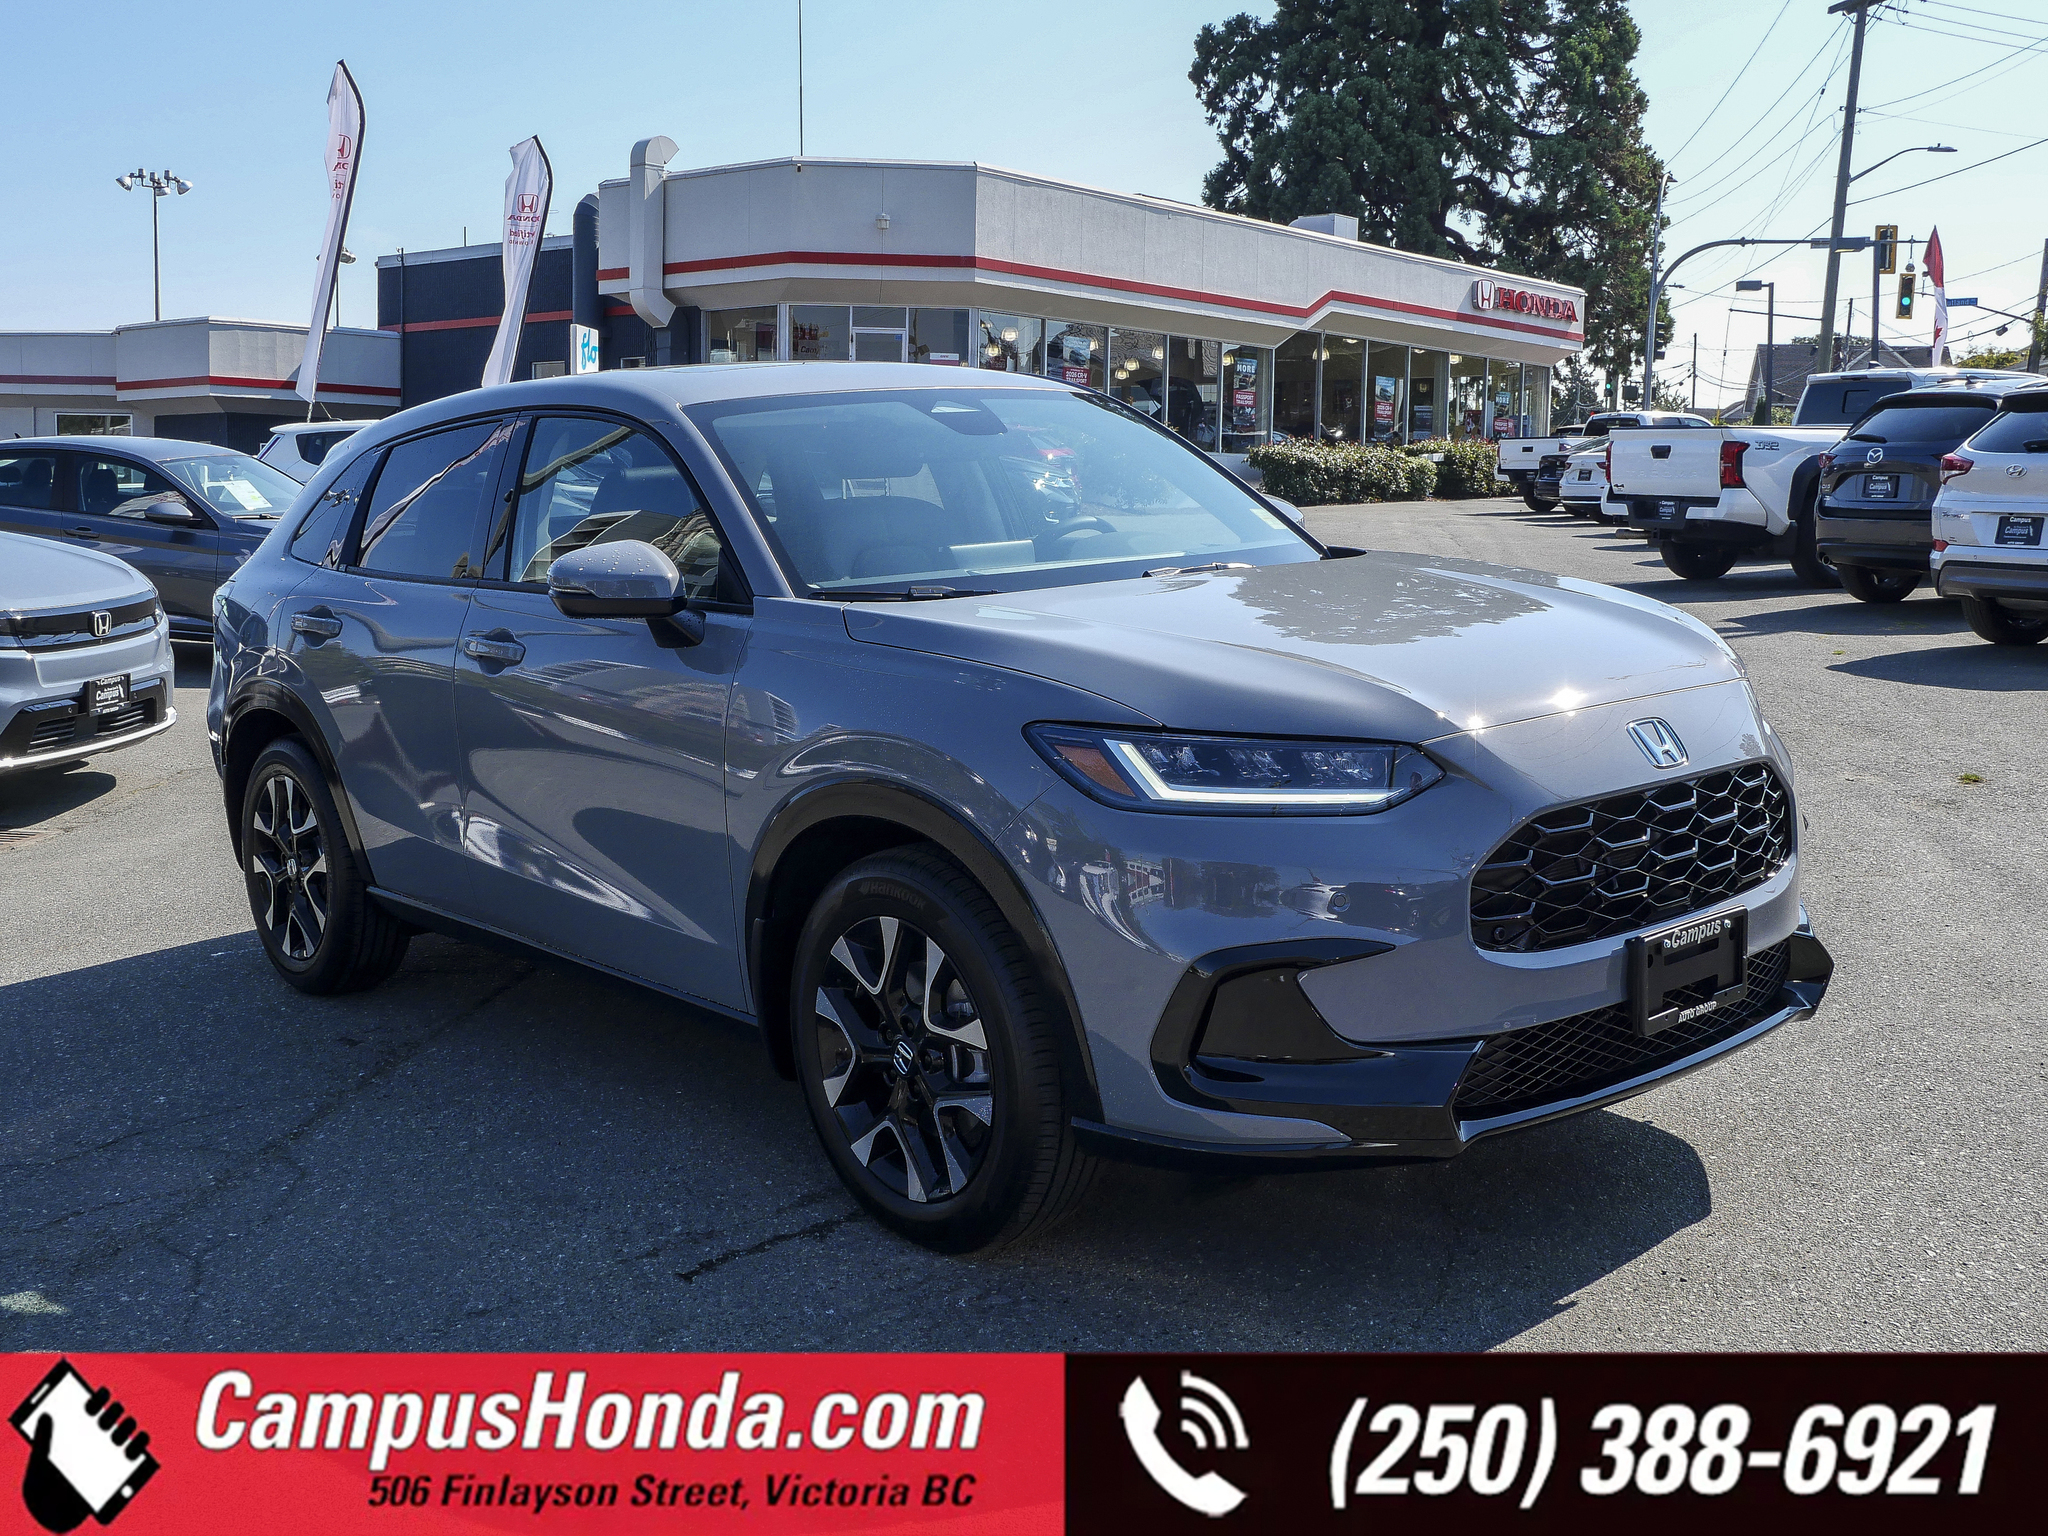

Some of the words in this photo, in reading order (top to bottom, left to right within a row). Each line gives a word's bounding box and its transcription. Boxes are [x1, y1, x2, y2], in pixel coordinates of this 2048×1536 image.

[1497, 286, 1579, 322] HONDA
[581, 328, 598, 370] flo
[1236, 364, 1256, 374] MORE
[2004, 526, 2029, 535] Campus
[100, 676, 121, 686] Campus
[96, 690, 120, 701] Campus
[1671, 919, 1722, 949] Campus
[1678, 1008, 1696, 1024] AUTO
[1695, 1000, 1717, 1016] GROUP
